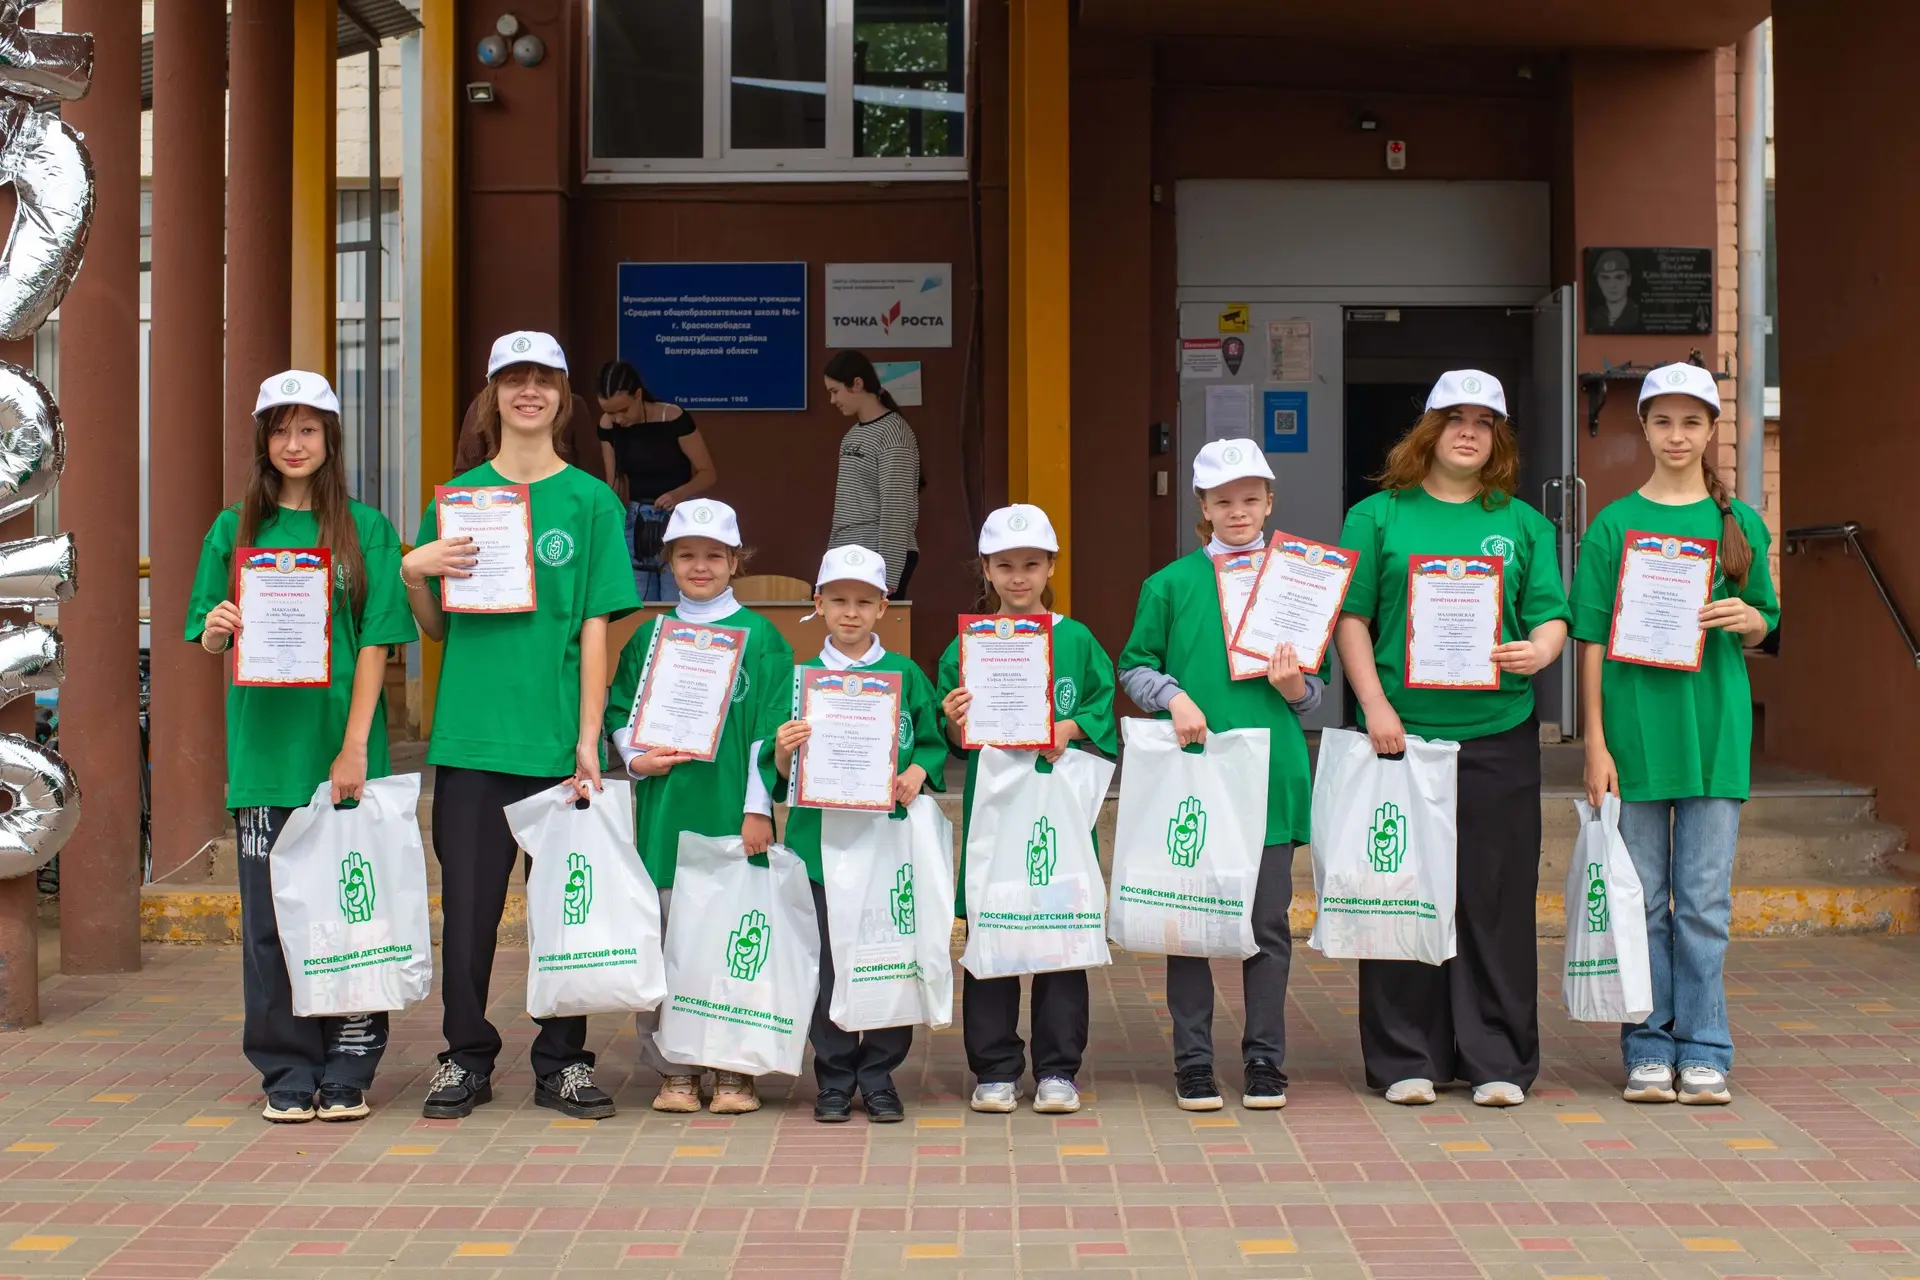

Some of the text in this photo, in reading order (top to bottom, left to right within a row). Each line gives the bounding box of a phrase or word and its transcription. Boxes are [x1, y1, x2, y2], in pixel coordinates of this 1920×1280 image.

[623, 296, 677, 304] Муниципальное
[680, 295, 757, 303] общеобразовательное
[624, 308, 660, 317] «Средняя
[664, 308, 751, 317] общеобразовательная
[682, 322, 751, 330] Краснослободска
[833, 316, 944, 326] ТОЧКА РОСТА
[656, 334, 767, 343] Среднеахтубинского района
[665, 347, 758, 356] Волгоградской области
[1121, 885, 1244, 908] РОССИЙСКИЙ ДЕТСКИЙ ФОНД
[1324, 897, 1381, 906] РОССИЙСКИЙ
[1120, 896, 1243, 916] ВОЛГОГРАДСКОЕ РЕГИОНАЛЬНОЕ ОТДЕЛЕНИЕ
[979, 912, 1101, 921] РОССИЙСКИЙ ДЕТСКИЙ ФОНД
[304, 951, 359, 966] РОССИЙСКИЙ
[573, 949, 610, 960] ДЕТСКИЙ
[612, 948, 637, 956] ФОНД
[305, 965, 350, 976] ВОЛГОГРАДСКОЕ
[351, 956, 396, 969] РЕГИОНАЛЬНОЕ
[674, 995, 794, 1026] РОССИЙСКИЙ ДЕТСКИЙ ФОНД
[672, 1006, 717, 1020] ВОЛГОГРАДСКОЕ
[719, 1015, 762, 1028] РЕГИОНАЛЬНОЕ
